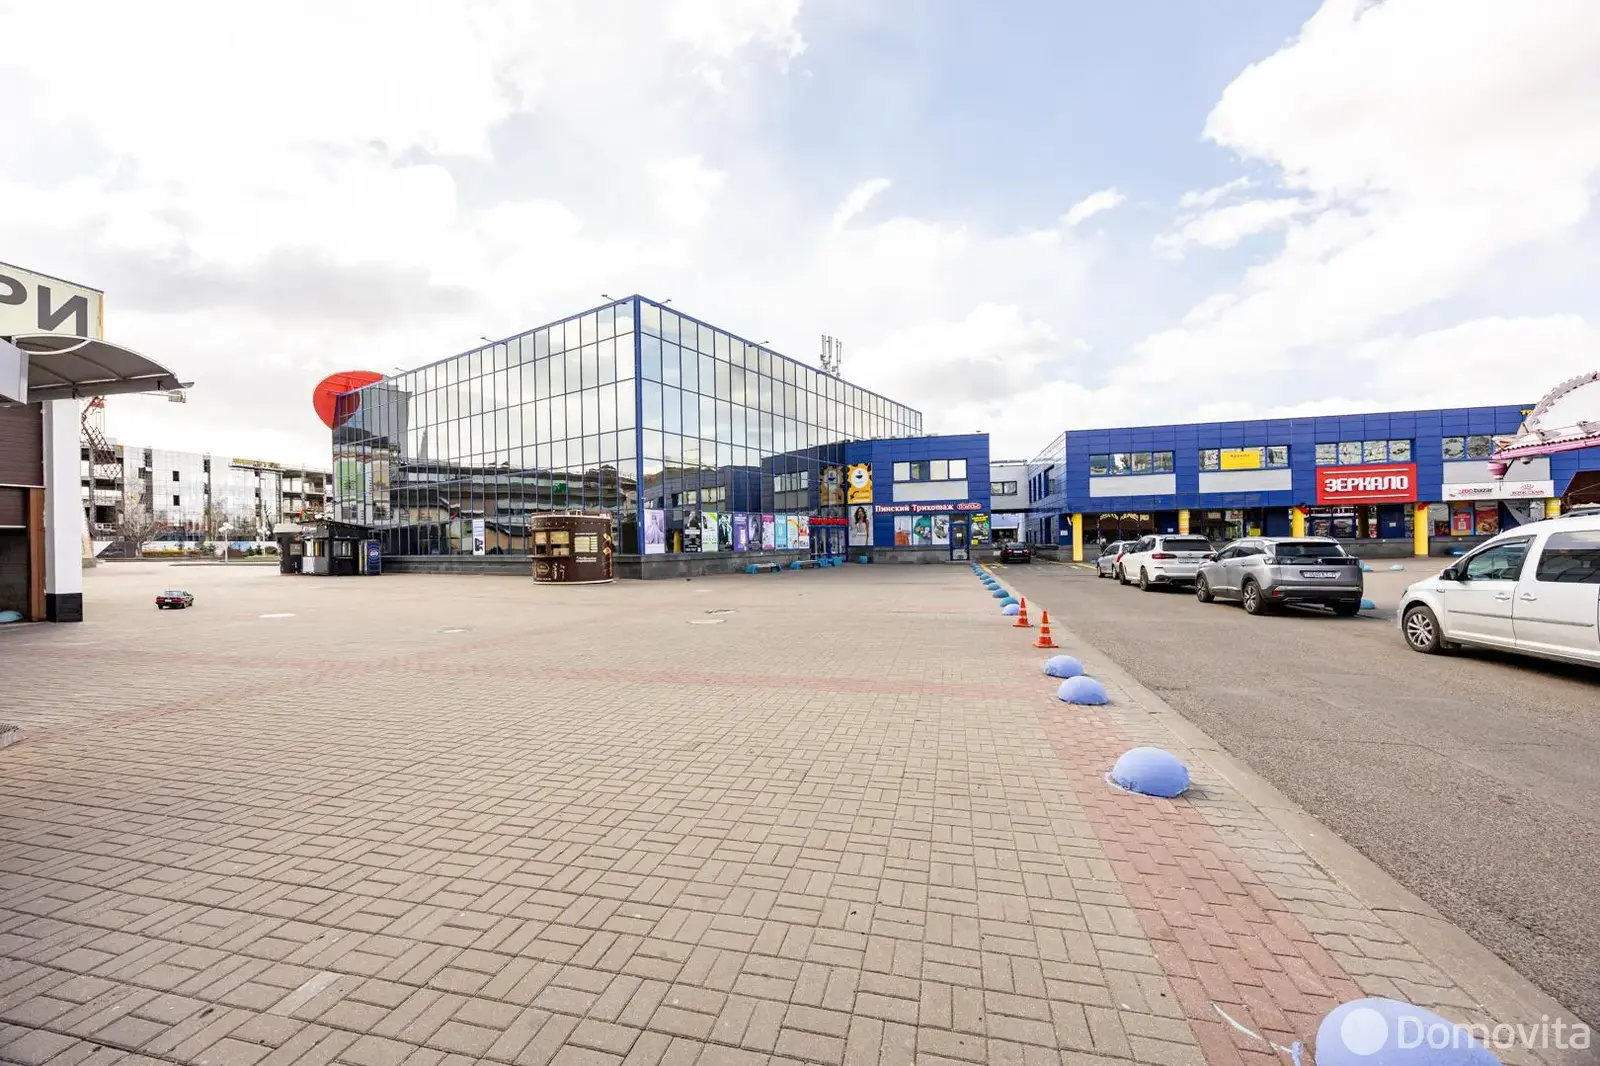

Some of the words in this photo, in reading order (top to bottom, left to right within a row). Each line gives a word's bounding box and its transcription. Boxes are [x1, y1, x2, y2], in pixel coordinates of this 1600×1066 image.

[1324, 475, 1408, 492] ЗЕРКАЛО
[875, 504, 910, 513] Пинский
[912, 503, 954, 512] Трикотаж
